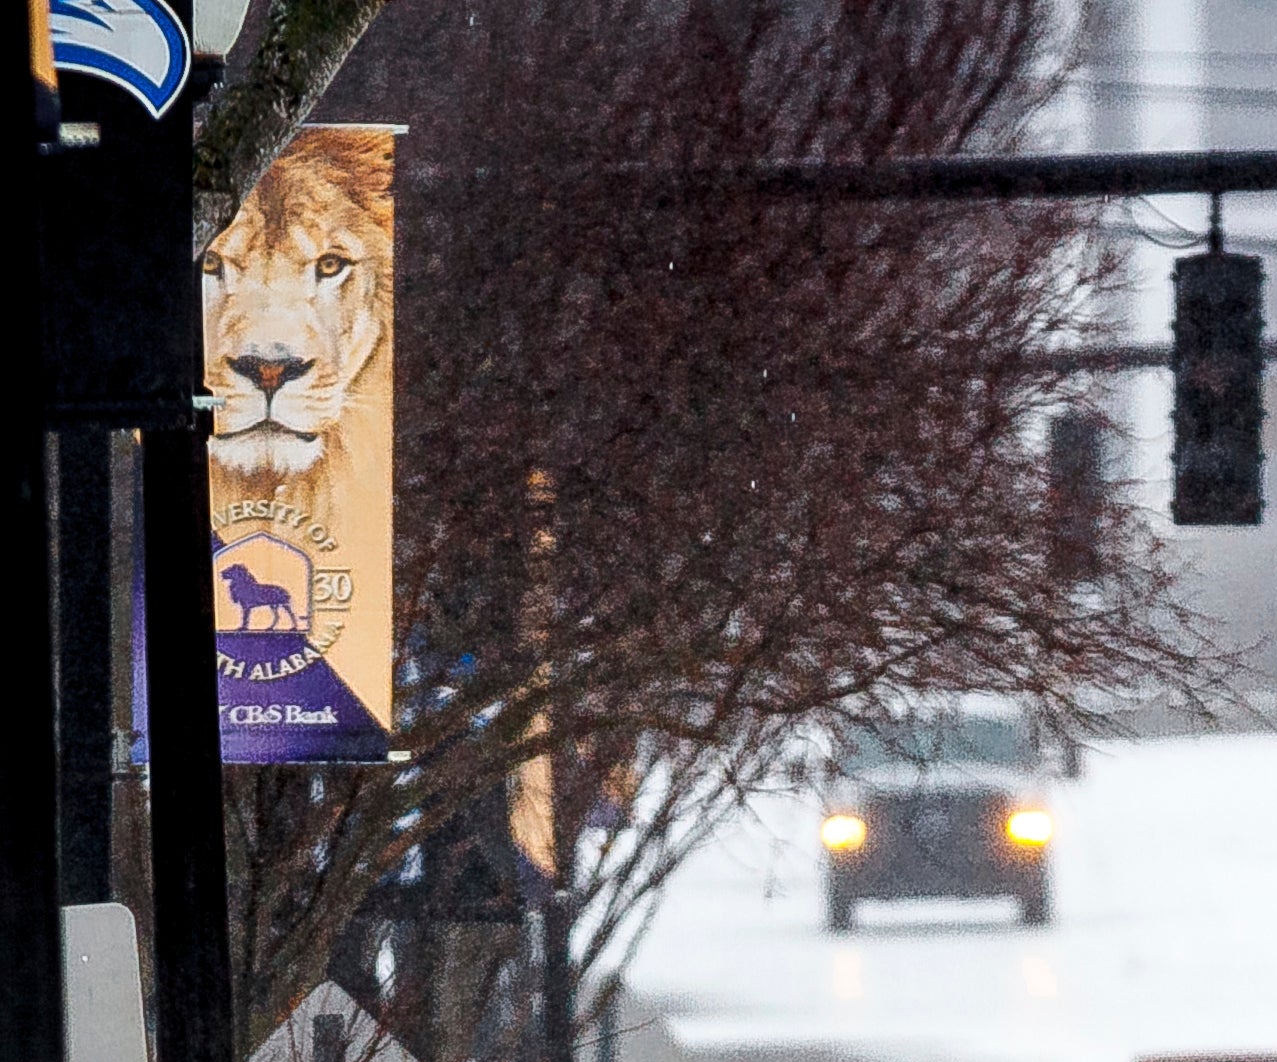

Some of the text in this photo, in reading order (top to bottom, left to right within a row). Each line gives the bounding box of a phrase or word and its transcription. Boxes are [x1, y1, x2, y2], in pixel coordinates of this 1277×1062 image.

[308, 523, 339, 552] OF
[313, 572, 352, 602] 30
[285, 704, 338, 725] Bank
